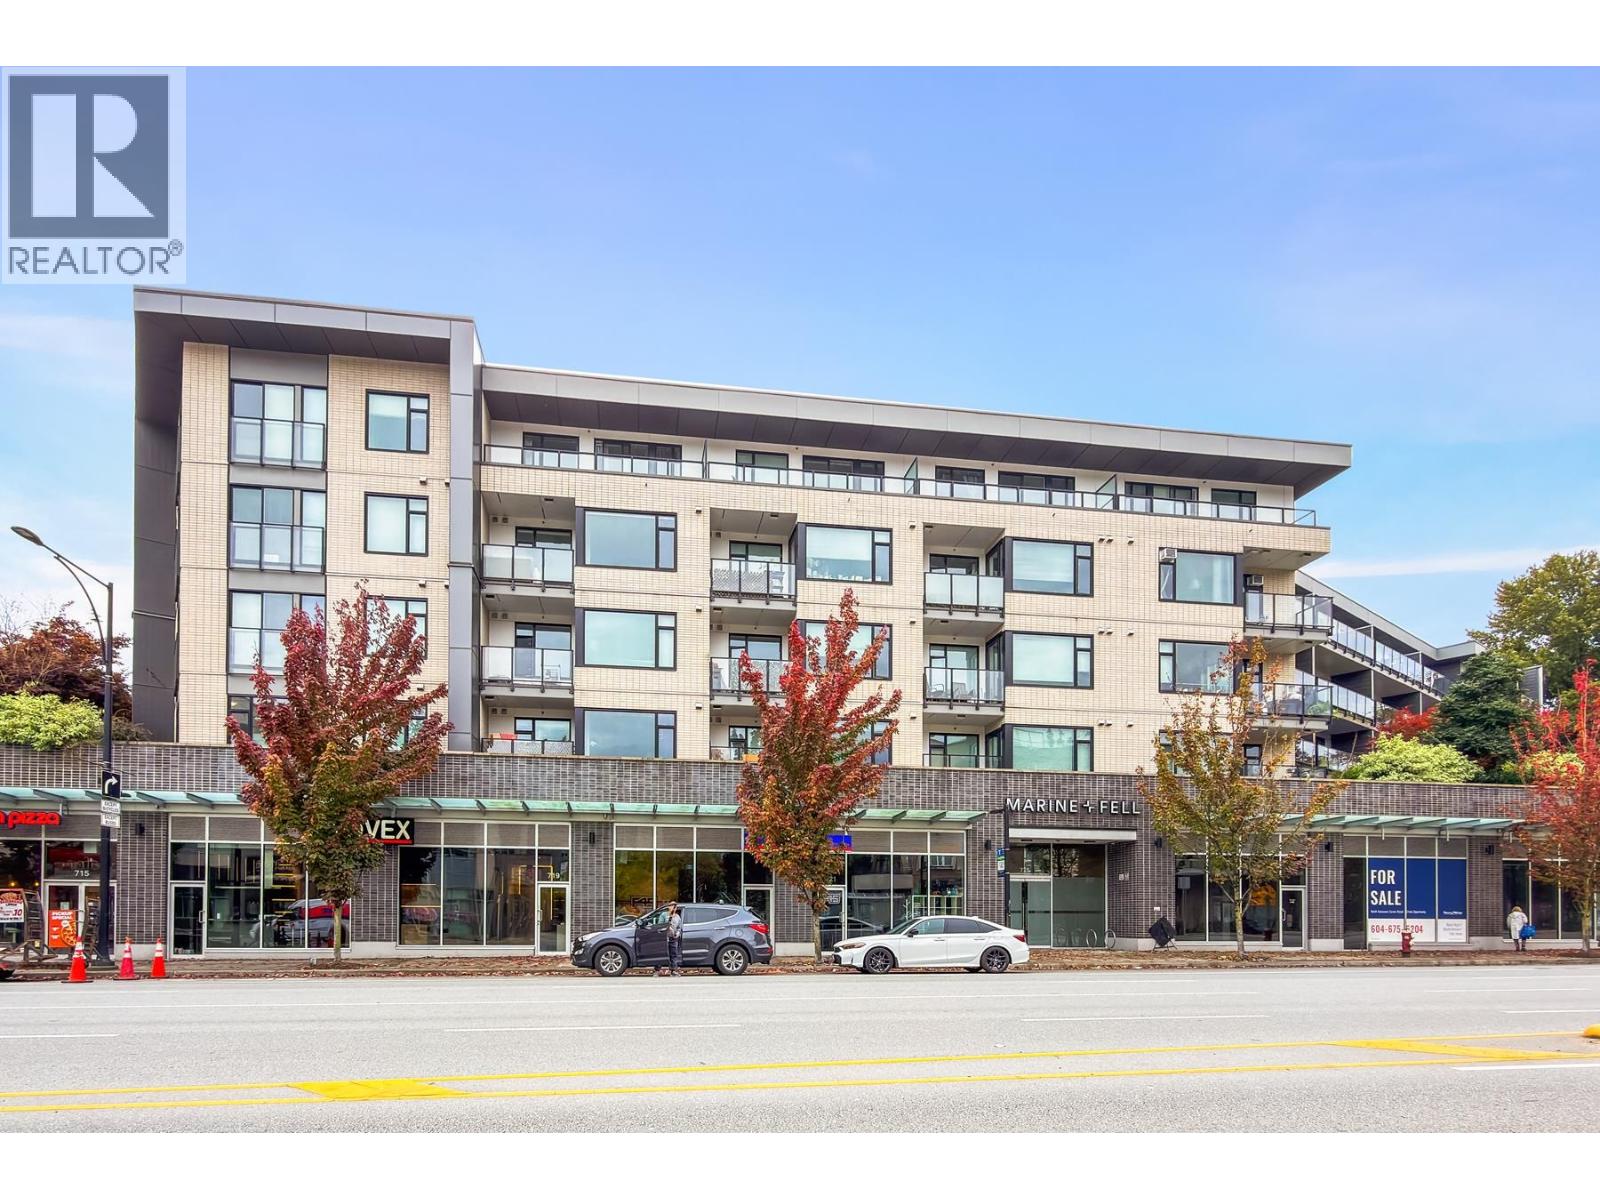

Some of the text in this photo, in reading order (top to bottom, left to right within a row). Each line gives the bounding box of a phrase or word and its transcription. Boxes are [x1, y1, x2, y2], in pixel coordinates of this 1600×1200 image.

[1006, 797, 1079, 813] MARINE
[1099, 800, 1141, 814] FELL
[8, 811, 60, 829] pizza
[74, 869, 90, 877] 715
[1370, 869, 1396, 885] FOR
[1370, 890, 1402, 906] SALE
